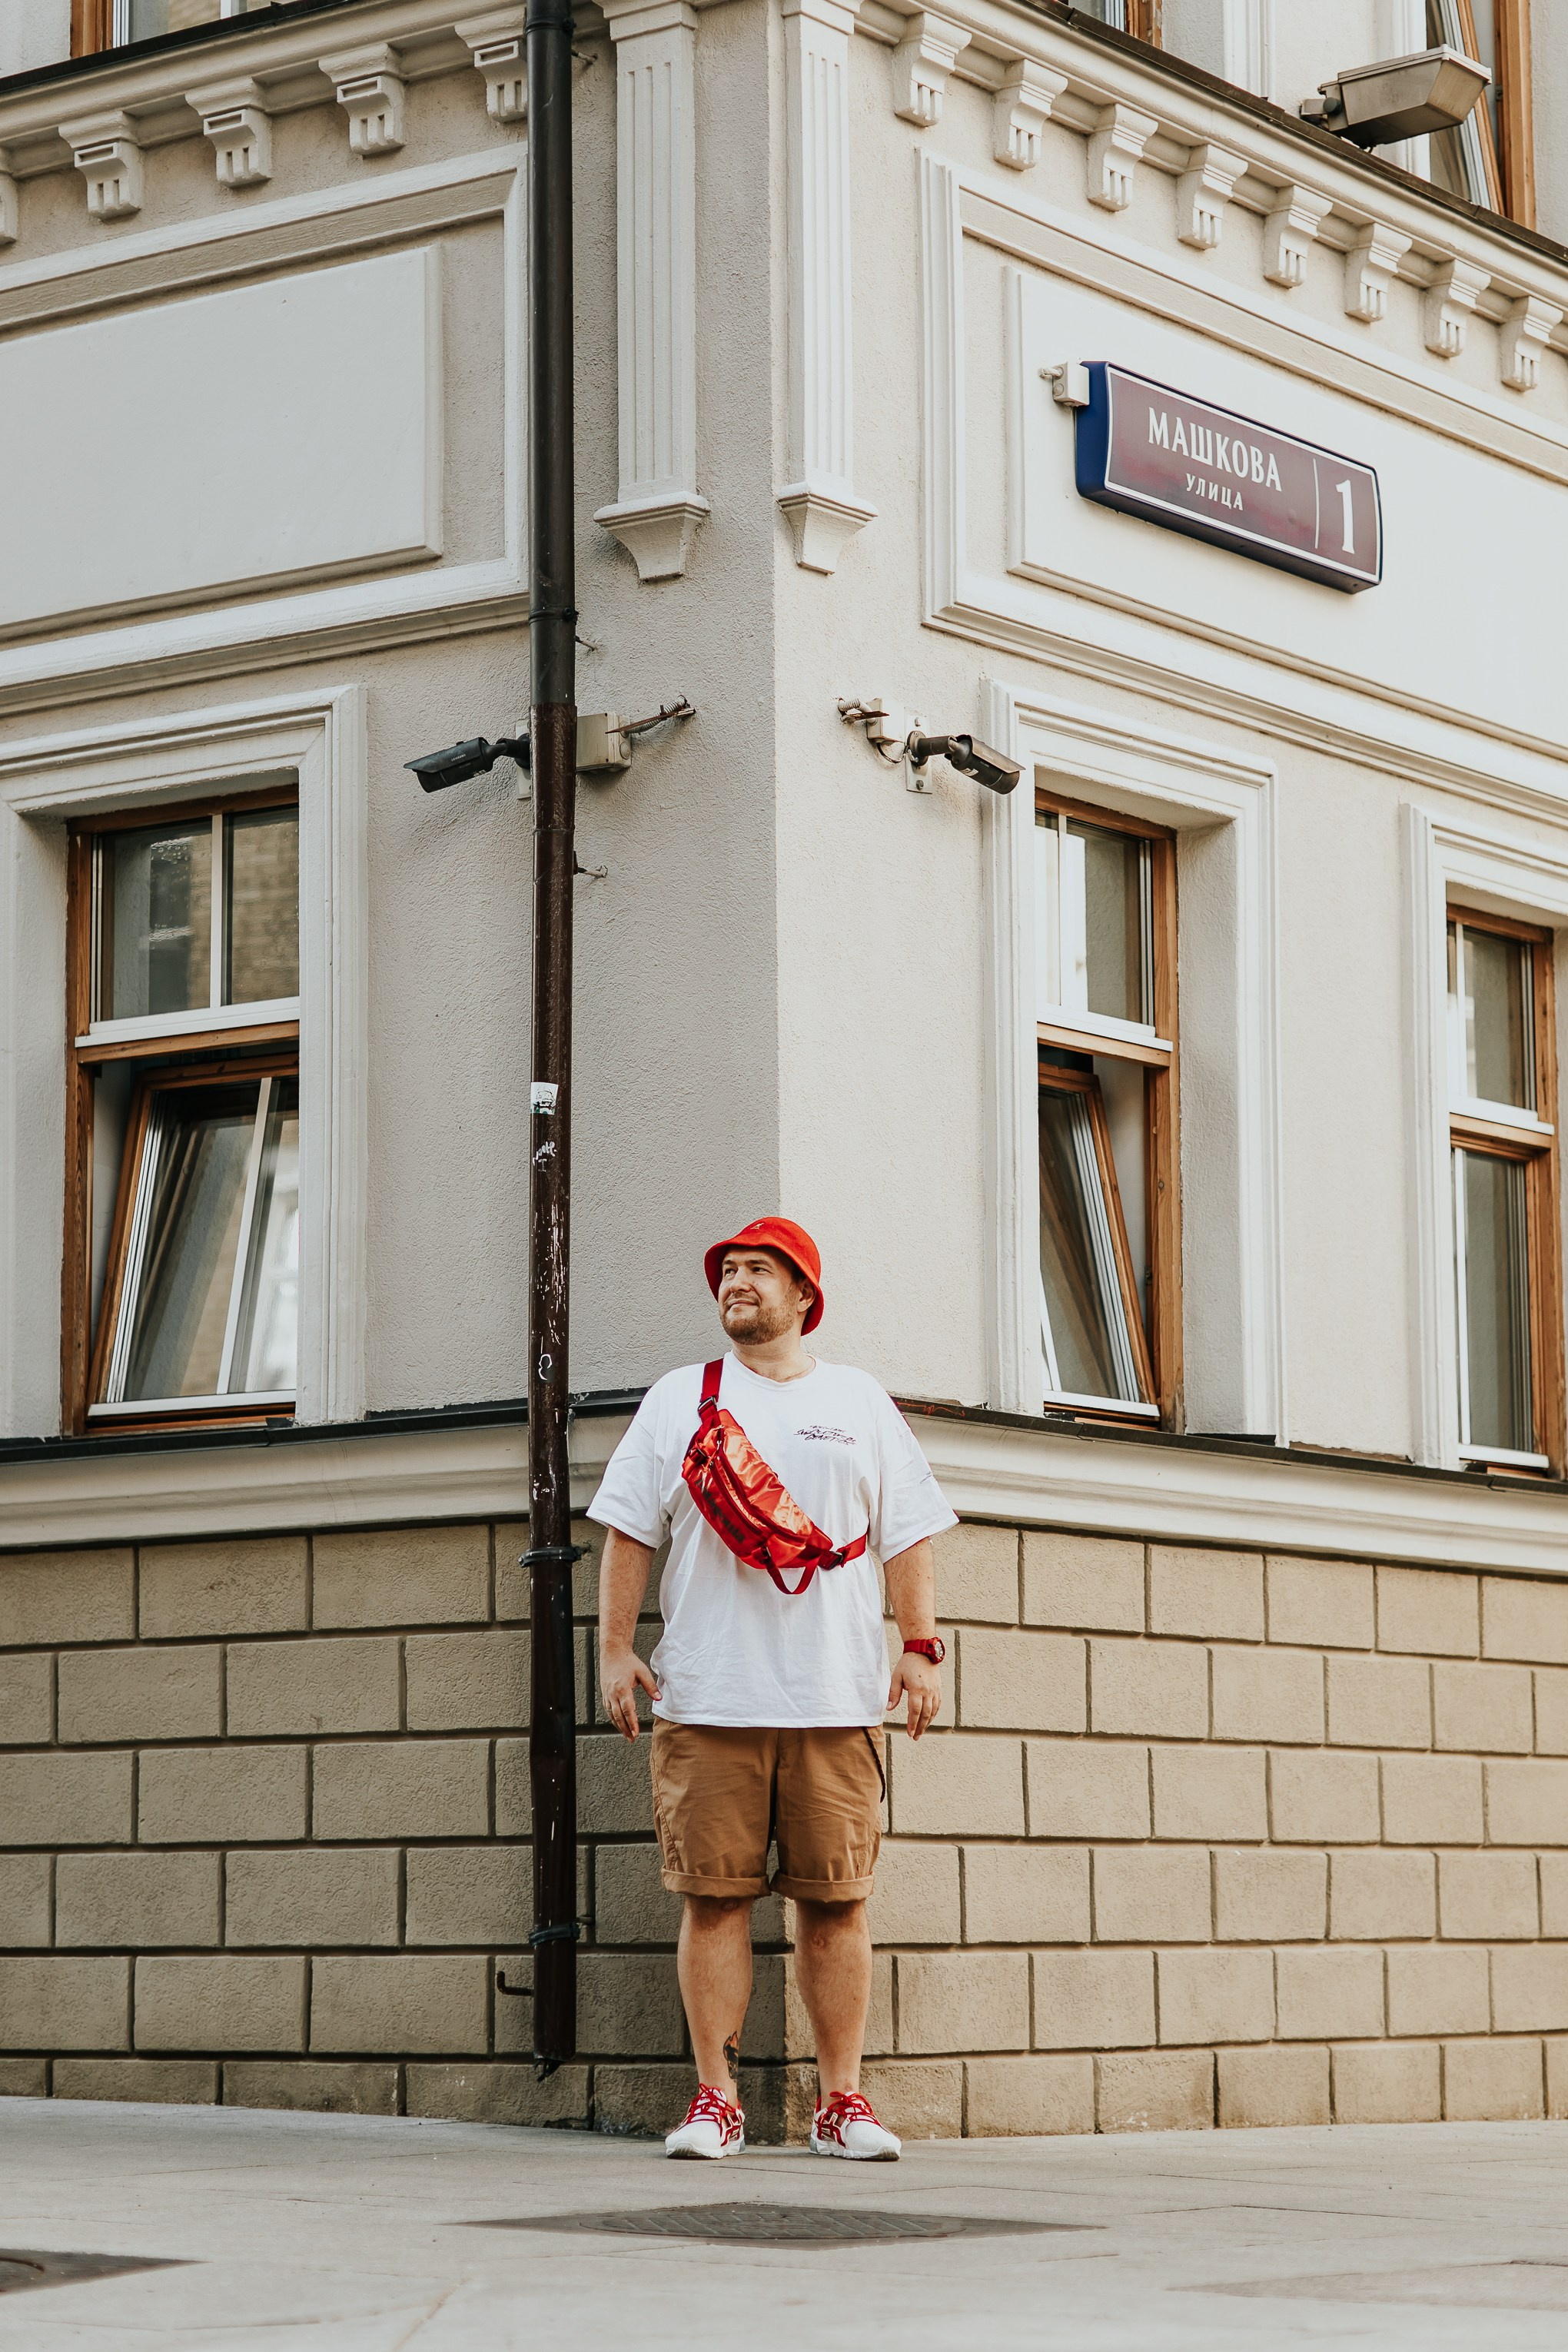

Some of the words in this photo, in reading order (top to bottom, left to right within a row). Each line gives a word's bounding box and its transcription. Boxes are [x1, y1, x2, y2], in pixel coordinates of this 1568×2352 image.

[1148, 407, 1282, 492] МАШКОВА
[1185, 473, 1244, 511] УЛИЦА
[1335, 479, 1355, 554] 1
